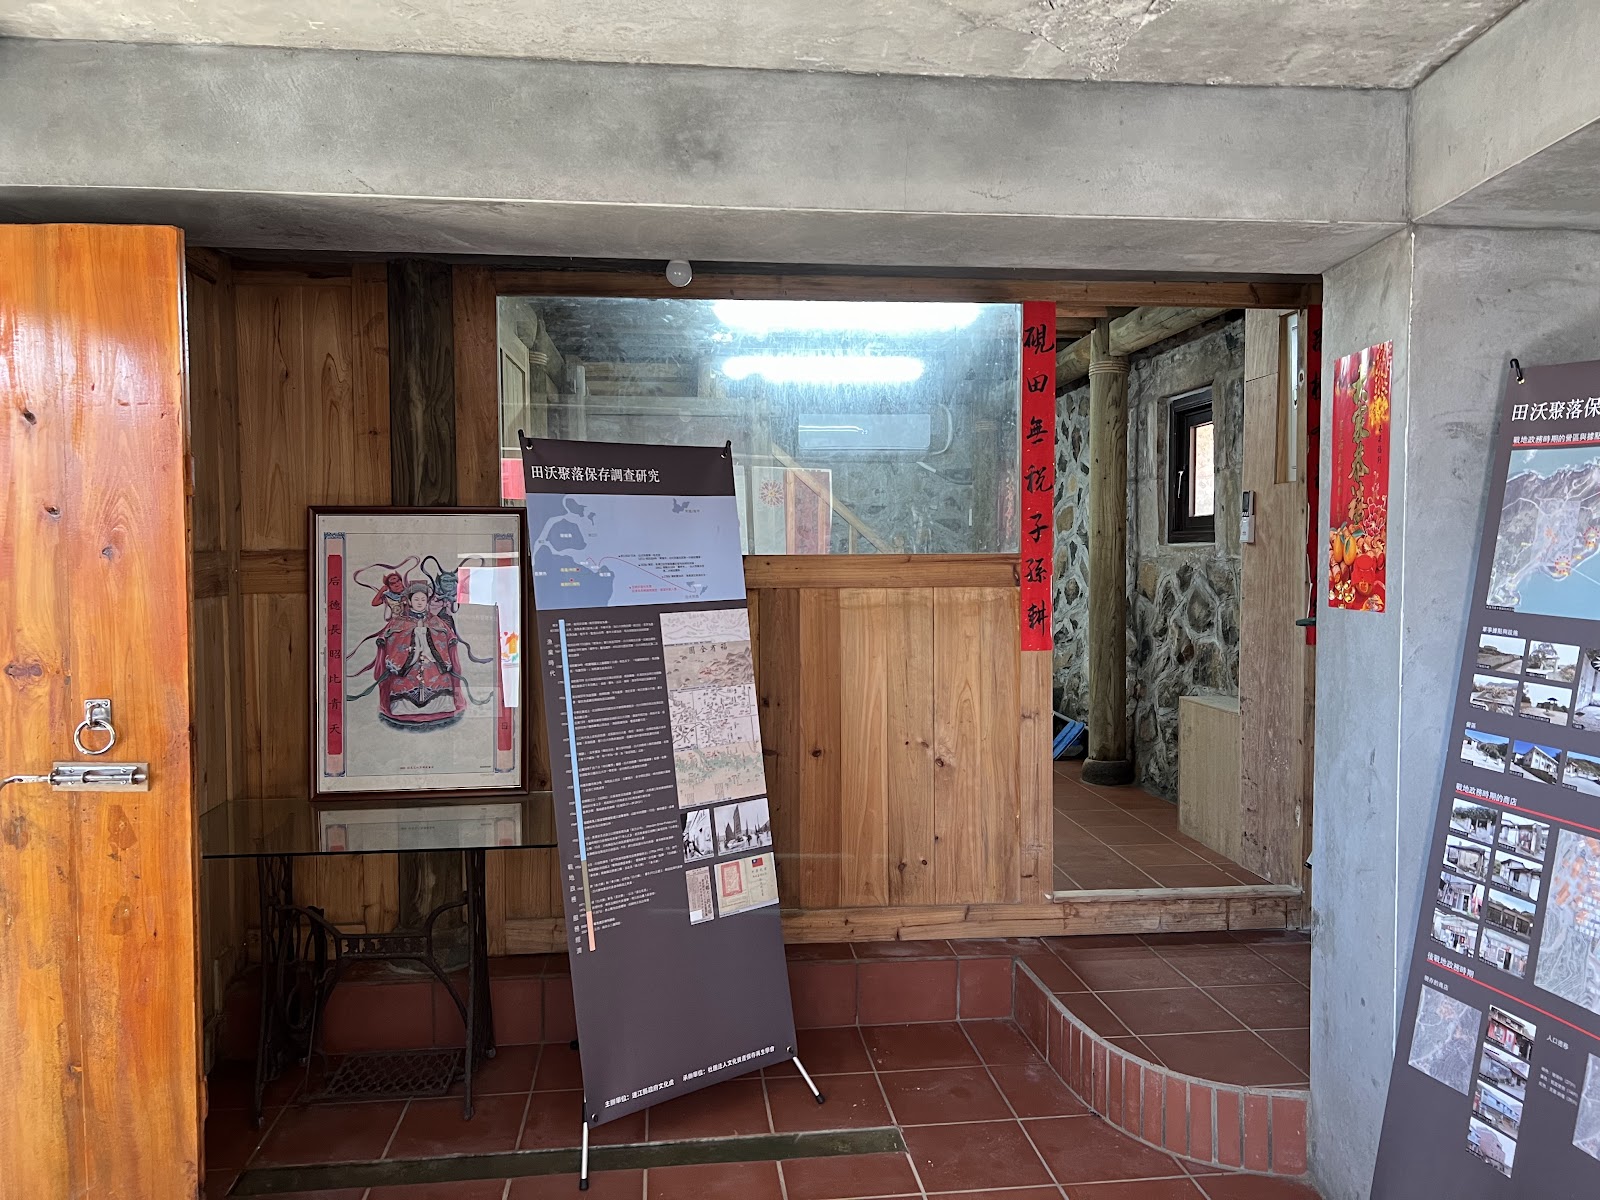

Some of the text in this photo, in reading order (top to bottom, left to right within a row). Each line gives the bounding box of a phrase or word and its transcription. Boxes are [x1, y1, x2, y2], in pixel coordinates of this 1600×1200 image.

[1511, 397, 1600, 421] 田沃聚落保
[531, 465, 661, 484] 田沃聚落保存調查研究
